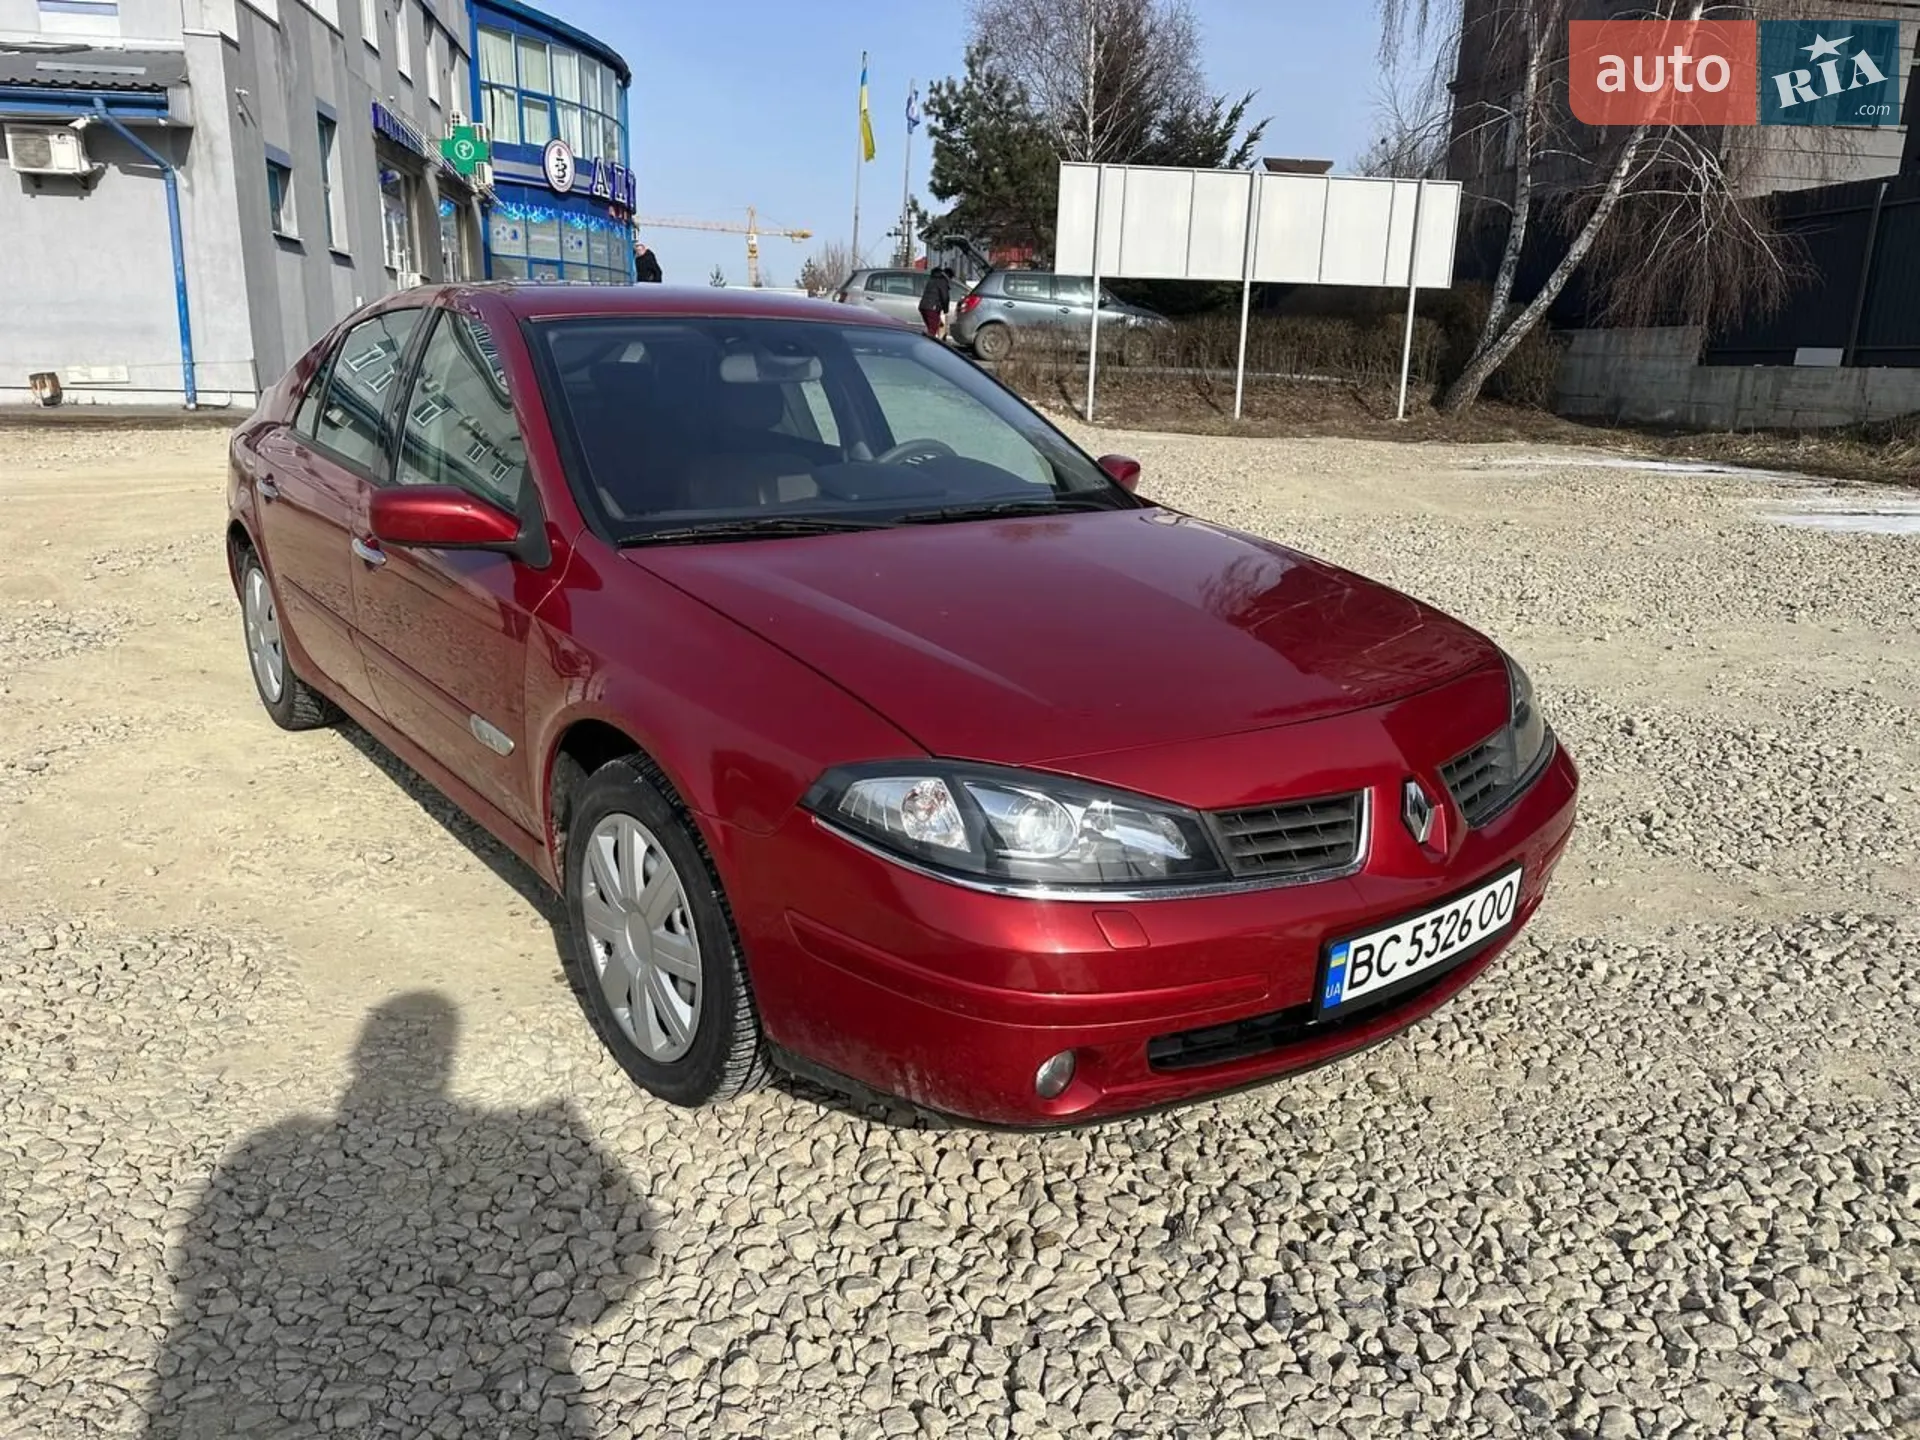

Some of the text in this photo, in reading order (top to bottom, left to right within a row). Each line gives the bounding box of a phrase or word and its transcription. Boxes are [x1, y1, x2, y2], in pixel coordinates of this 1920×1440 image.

[1347, 933, 1401, 991] BC
[1405, 899, 1476, 967] 5326
[1325, 982, 1341, 999] UA
